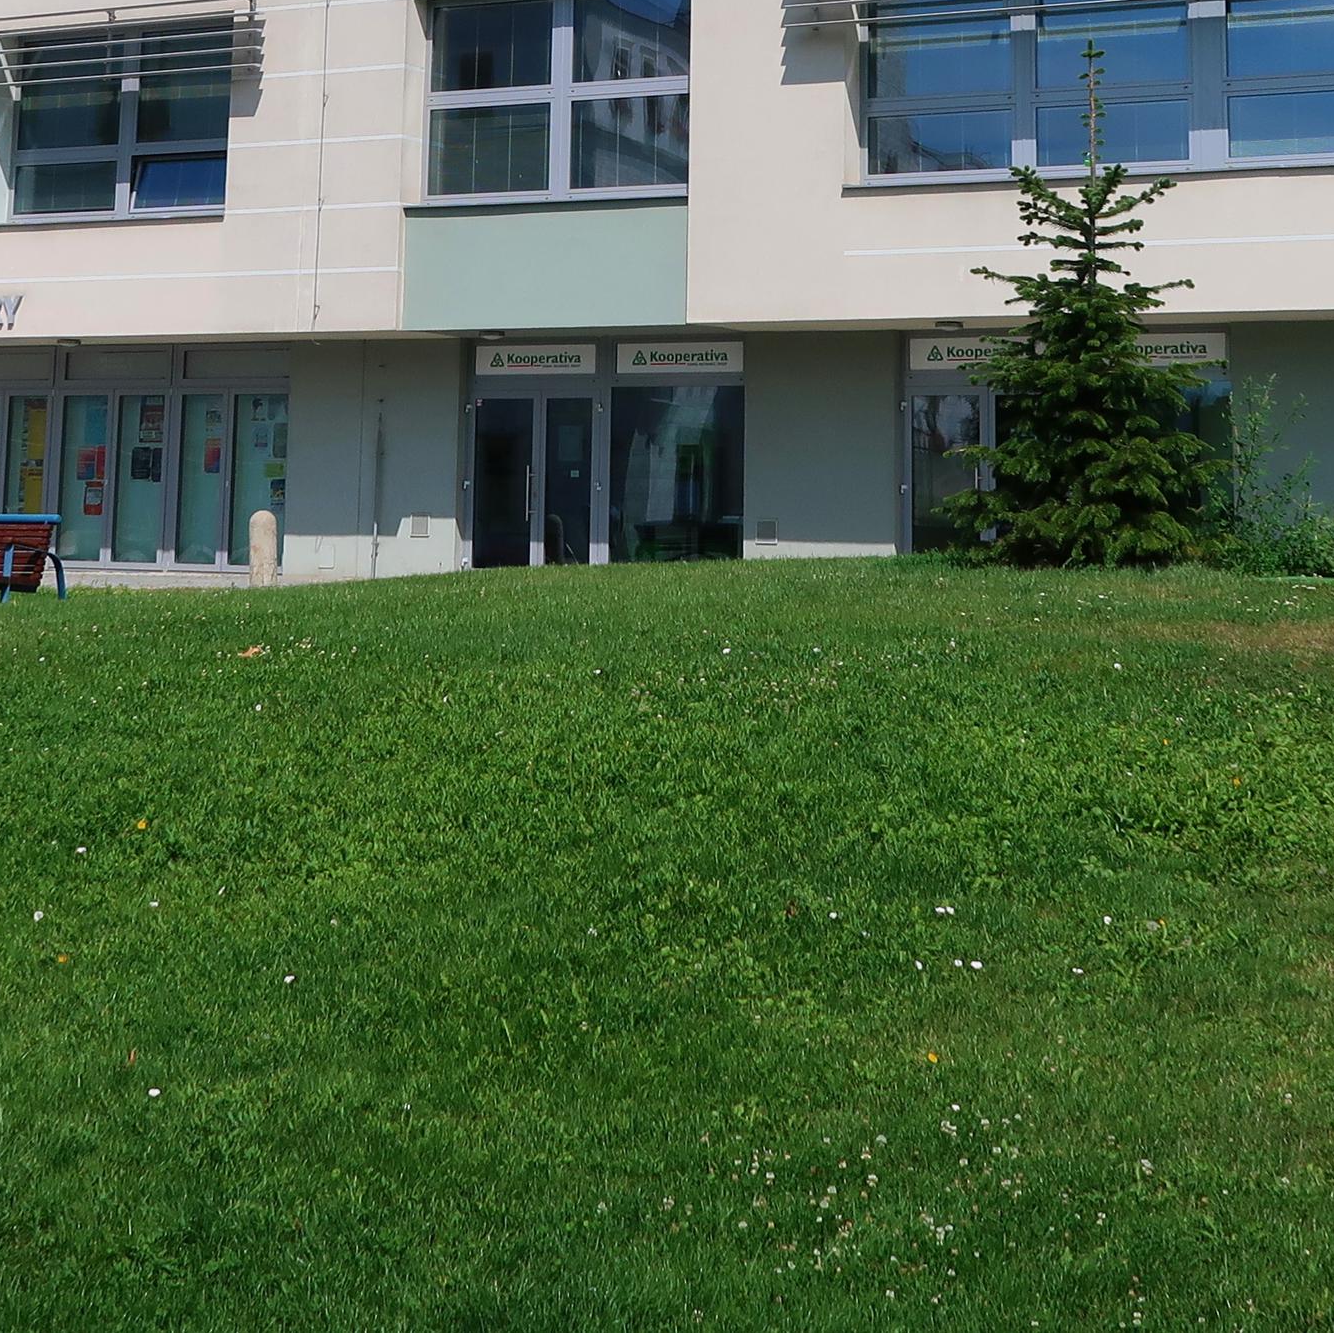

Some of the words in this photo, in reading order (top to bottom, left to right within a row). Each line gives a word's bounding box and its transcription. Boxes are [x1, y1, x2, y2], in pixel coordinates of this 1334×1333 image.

[1135, 341, 1207, 356] operativa
[507, 351, 581, 365] Kooperativa
[650, 349, 728, 364] Kooperativa
